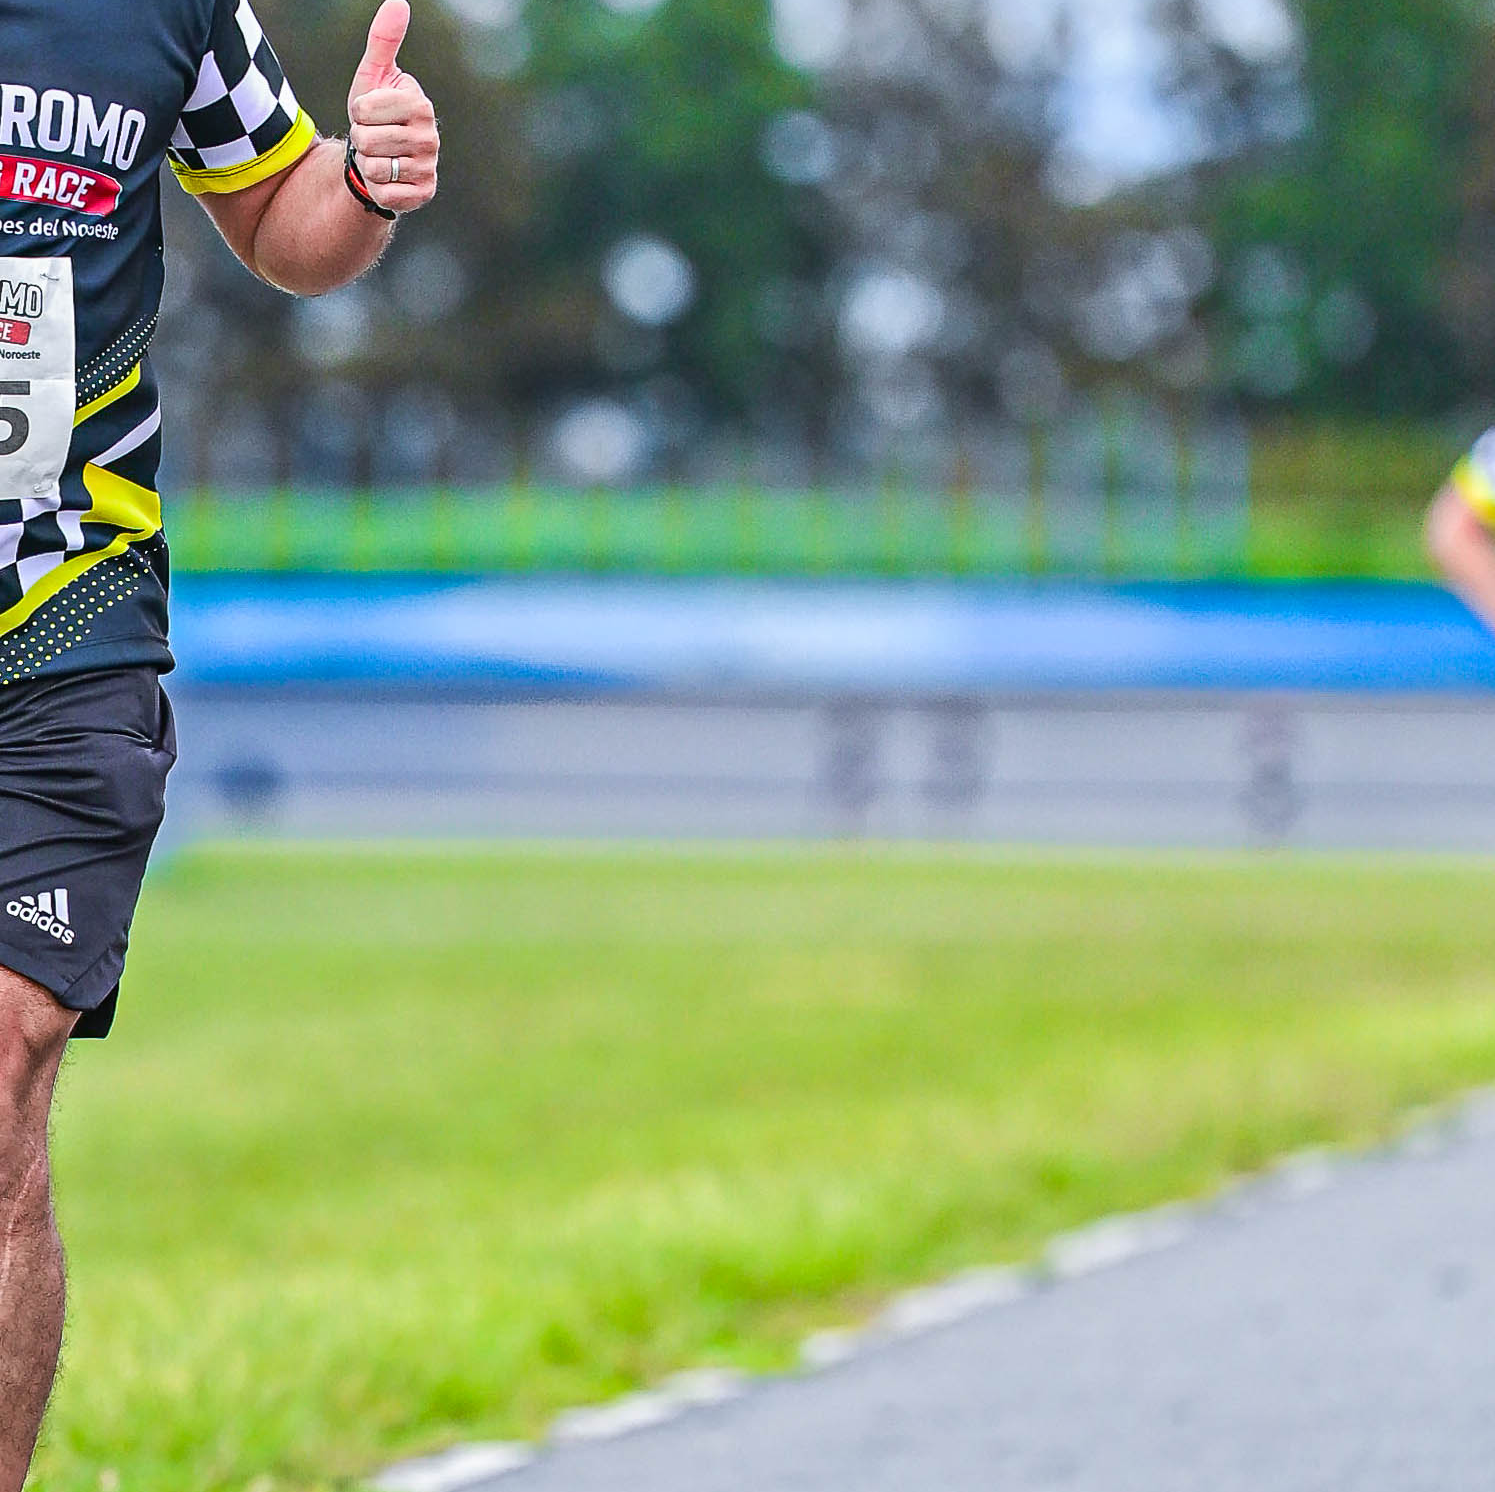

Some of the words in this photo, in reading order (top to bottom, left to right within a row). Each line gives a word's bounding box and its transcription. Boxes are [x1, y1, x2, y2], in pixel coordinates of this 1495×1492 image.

[11, 161, 96, 208] RACE
[29, 217, 59, 236] del
[6, 900, 75, 945] adidas
